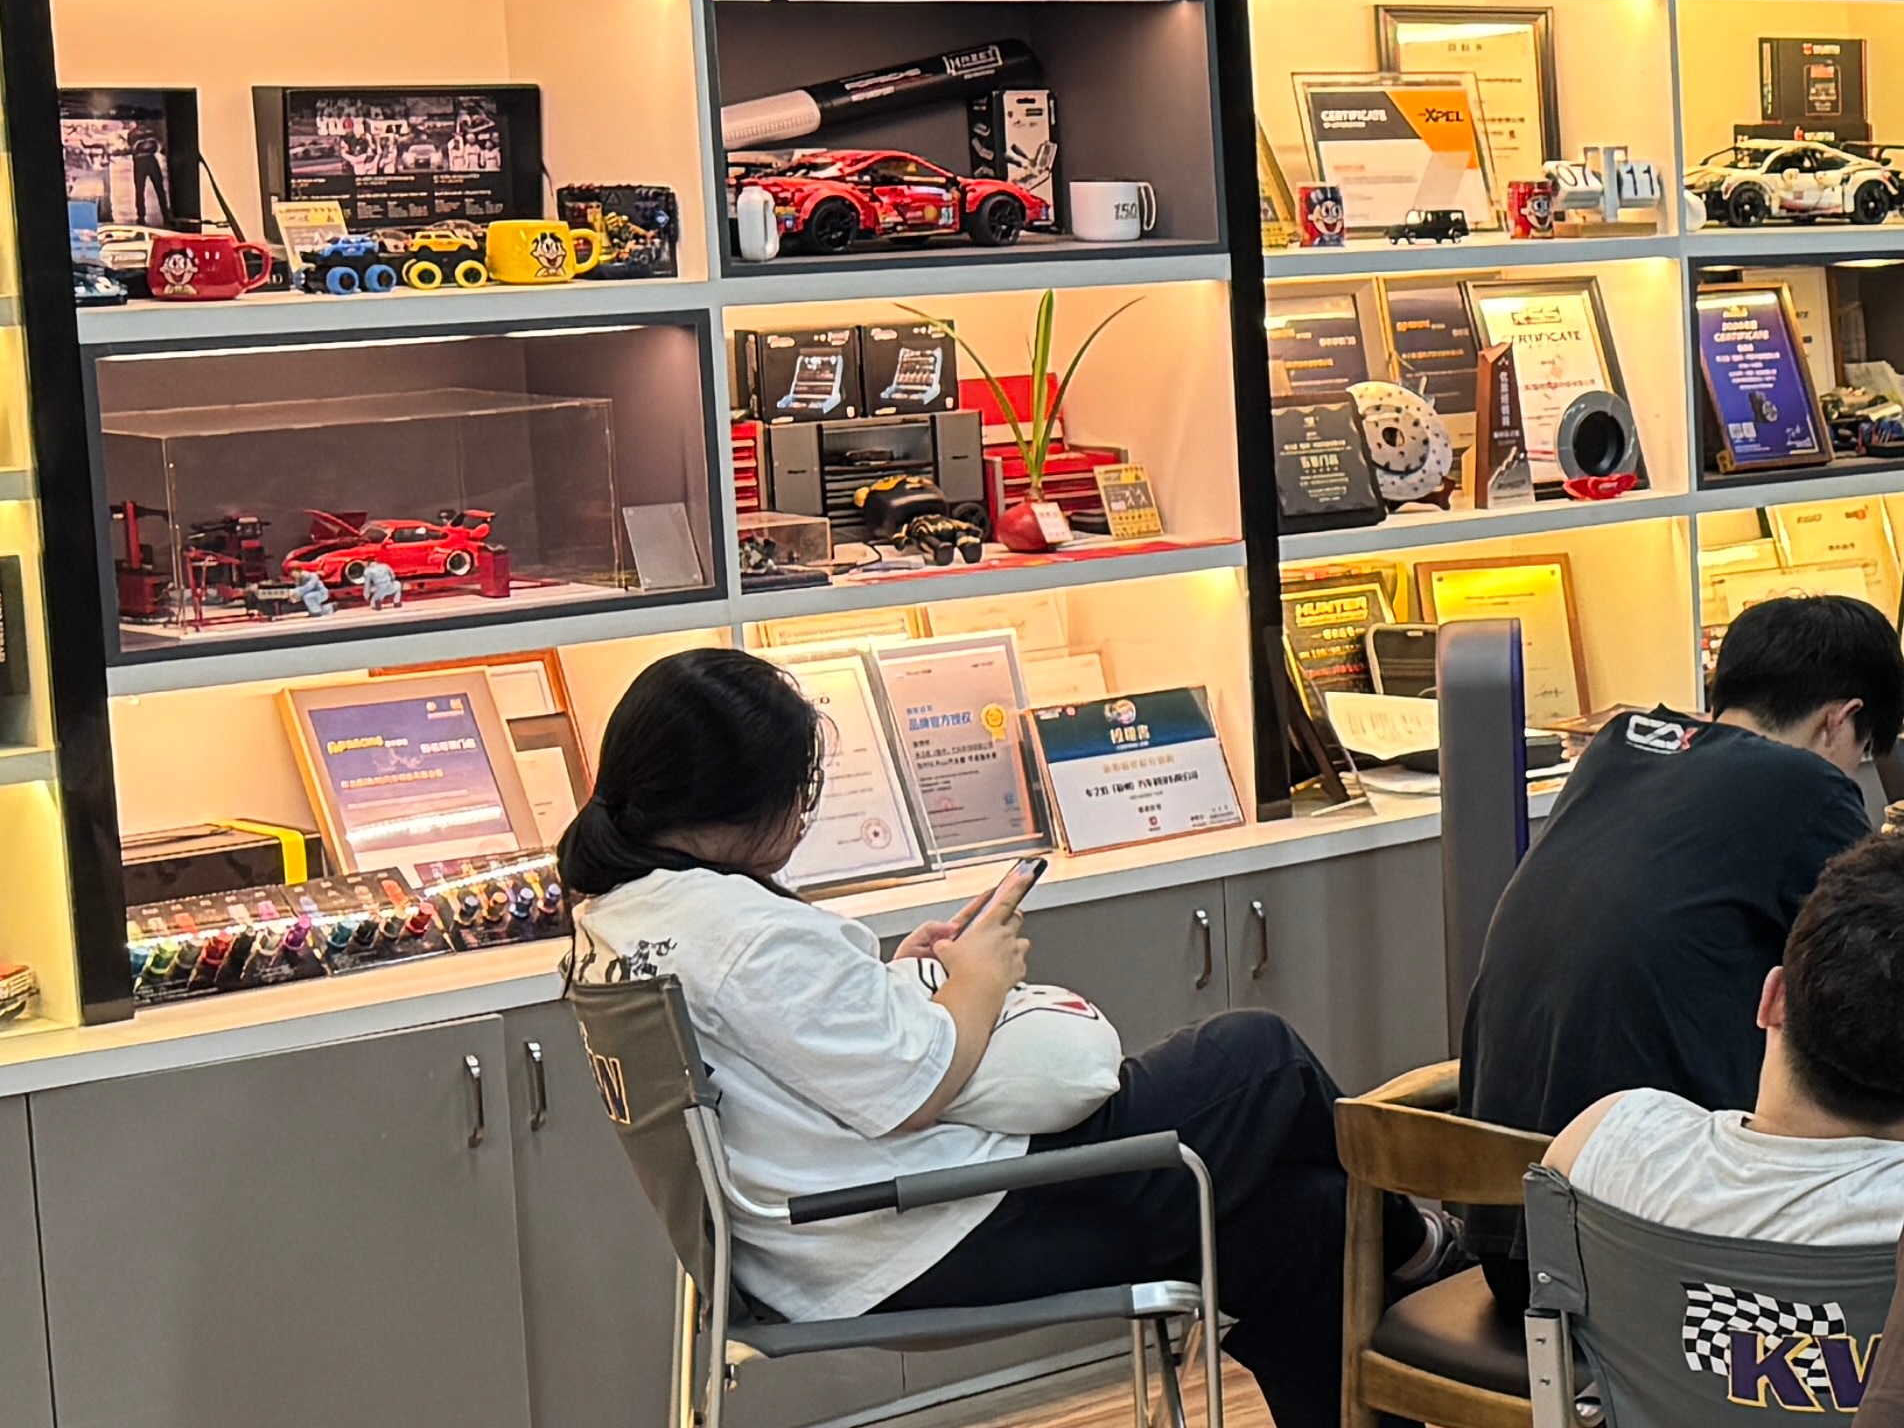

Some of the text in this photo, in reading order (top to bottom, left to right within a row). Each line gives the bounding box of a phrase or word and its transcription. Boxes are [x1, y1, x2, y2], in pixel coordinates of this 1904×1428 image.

[1320, 109, 1388, 123] CERTIFICATE
[1424, 108, 1465, 124] XPEL
[1556, 164, 1592, 187] 07
[1625, 165, 1657, 196] 11
